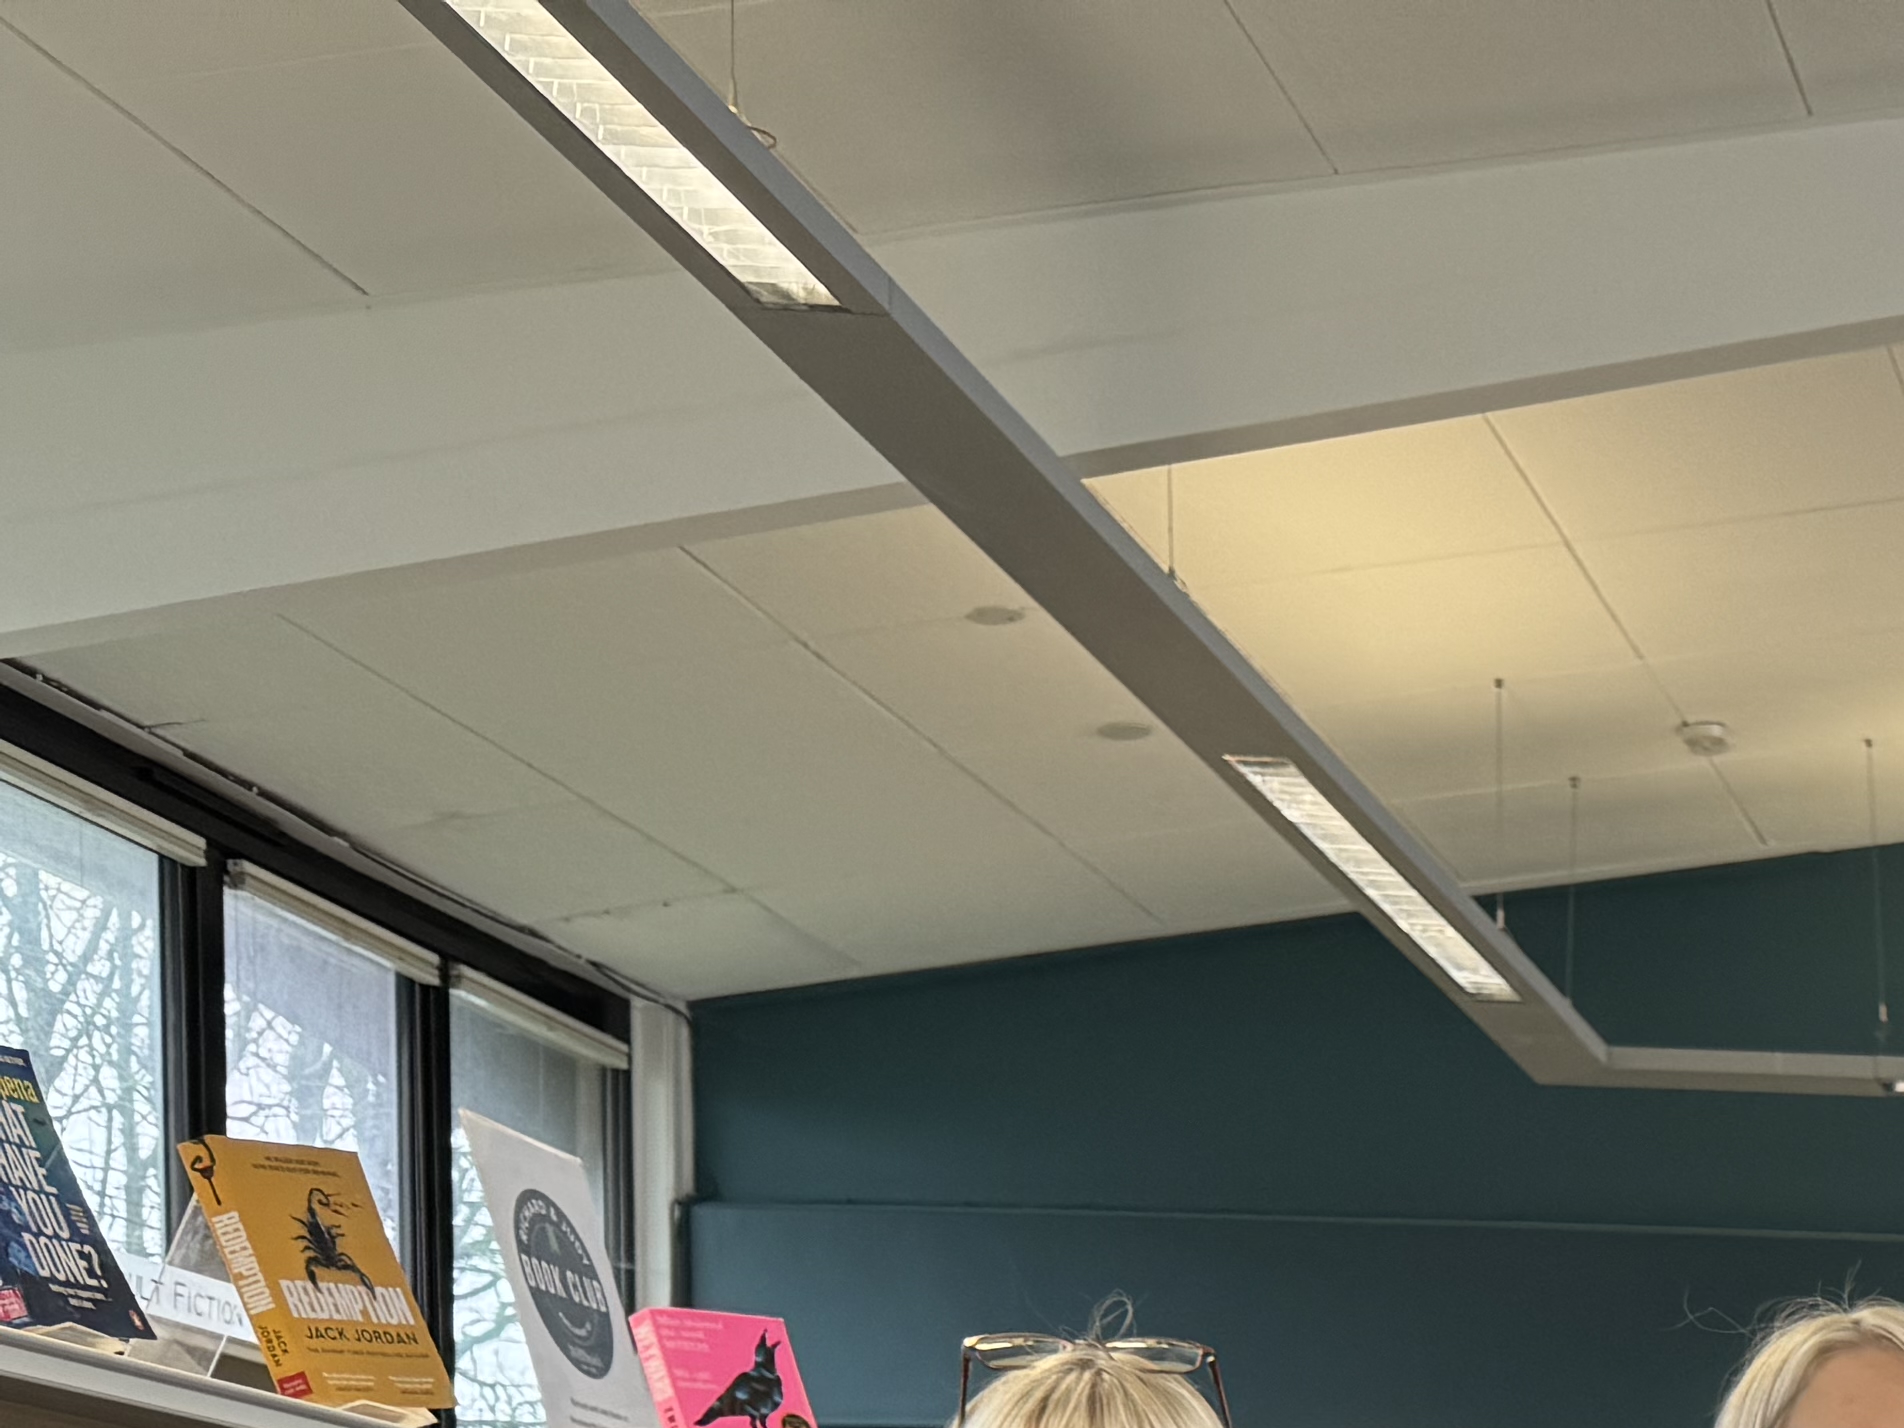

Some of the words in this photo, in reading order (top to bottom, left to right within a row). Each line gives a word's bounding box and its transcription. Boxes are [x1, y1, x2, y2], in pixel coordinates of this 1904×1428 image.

[9, 1186, 71, 1240] YOU
[22, 1232, 109, 1289] DONE?
[212, 1210, 276, 1316] REDEMPTION
[520, 1253, 568, 1299] BOOK
[565, 1270, 608, 1313] CLUB
[278, 1279, 415, 1326] REDEMPTION
[306, 1325, 350, 1342] JACK
[354, 1327, 419, 1346] JORDAN
